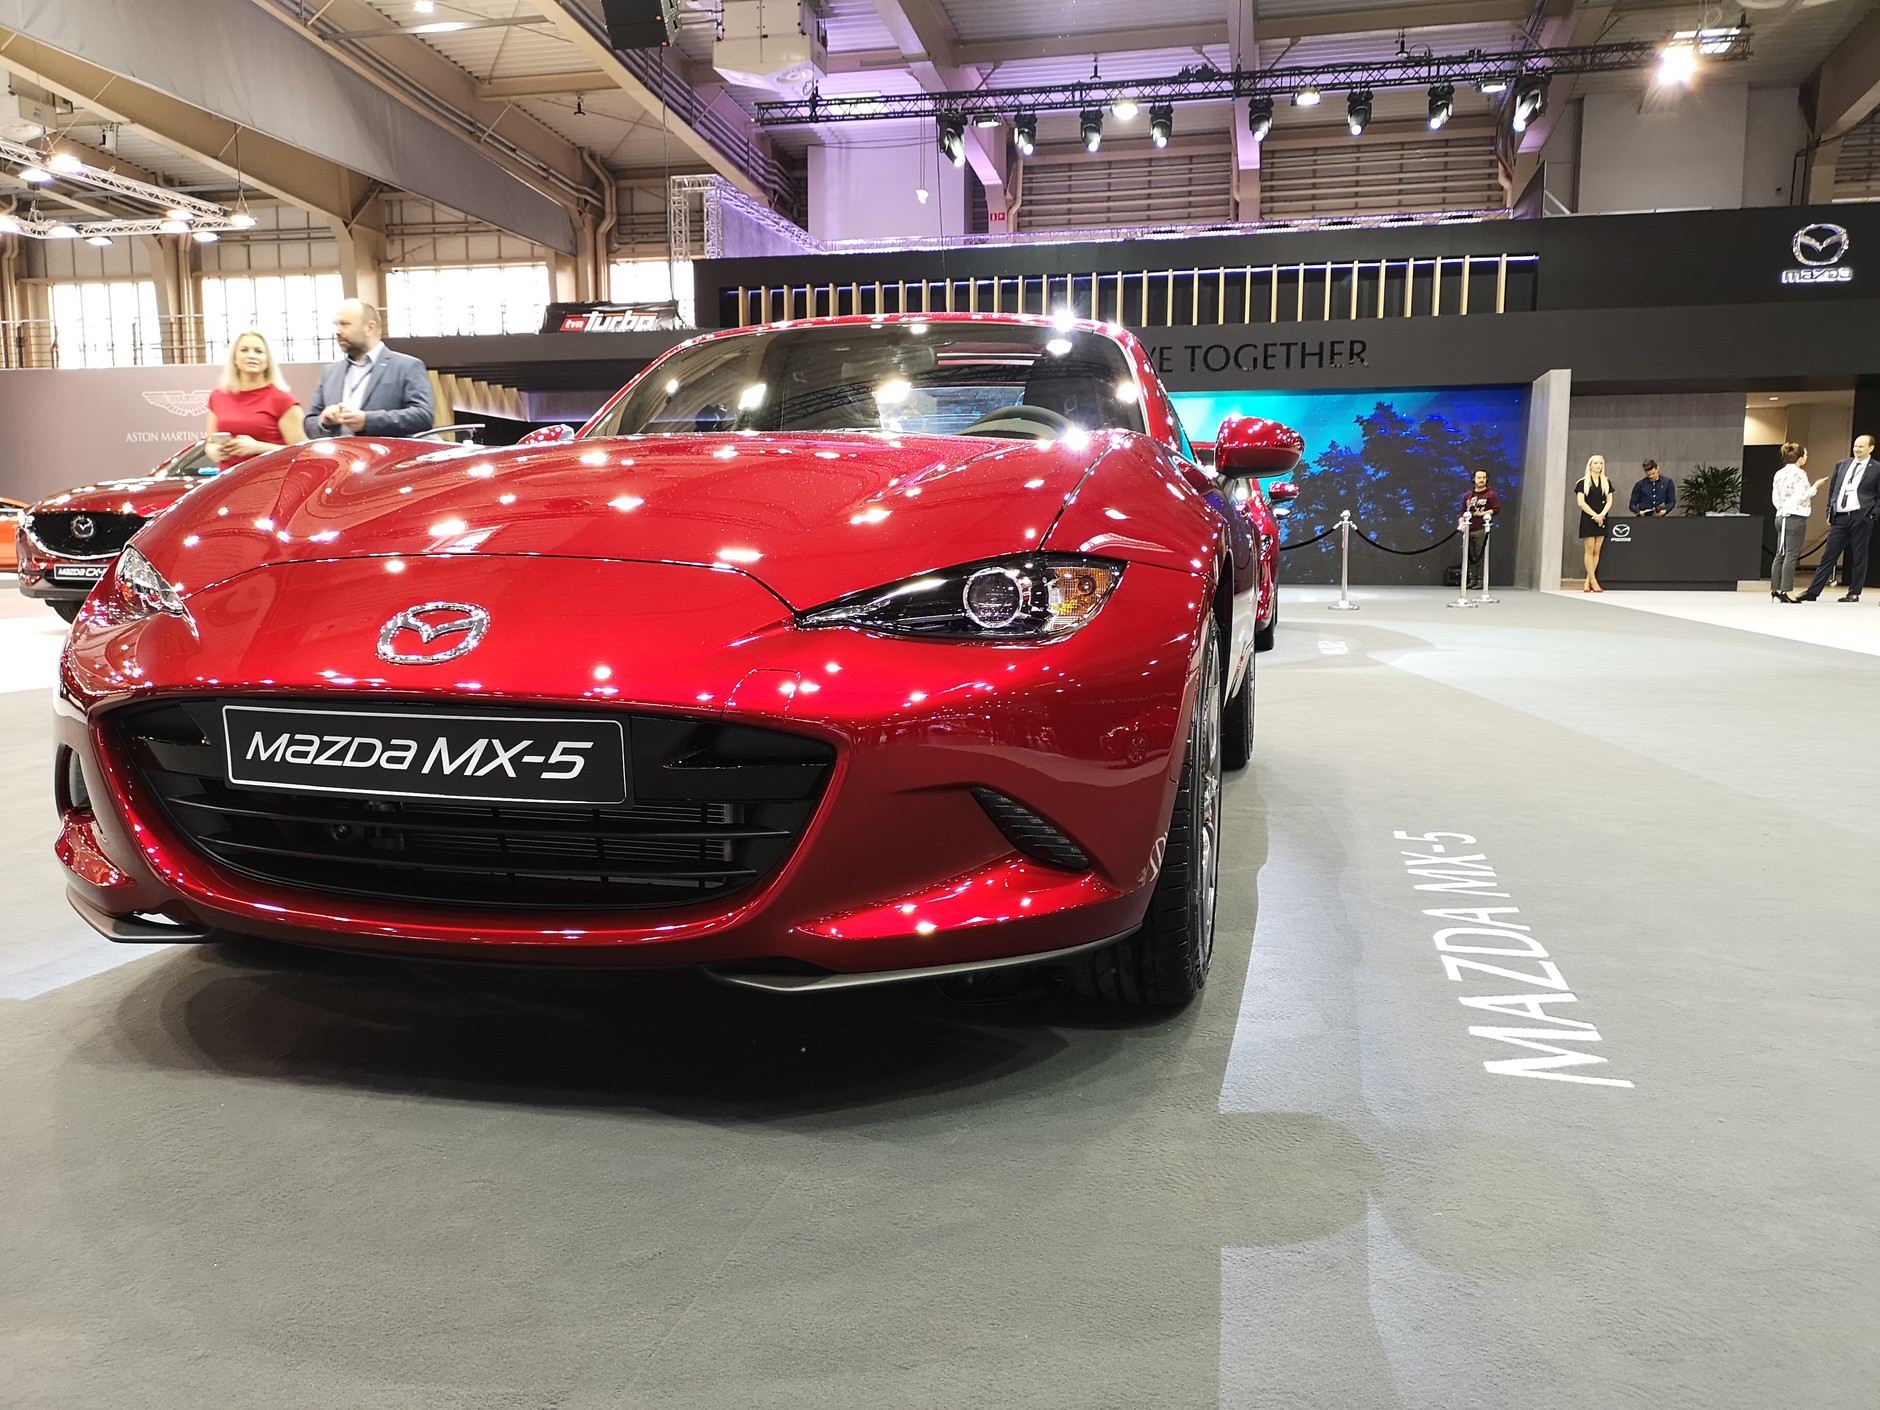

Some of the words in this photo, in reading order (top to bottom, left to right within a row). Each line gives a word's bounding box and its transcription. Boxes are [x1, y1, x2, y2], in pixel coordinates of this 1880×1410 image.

[1184, 340, 1370, 373] TOGETHER
[125, 431, 159, 443] ASTON
[161, 431, 199, 442] MARTIN
[420, 736, 594, 779] MX-5
[1392, 829, 1512, 898] MX-5
[1421, 906, 1636, 1089] MAZDA
